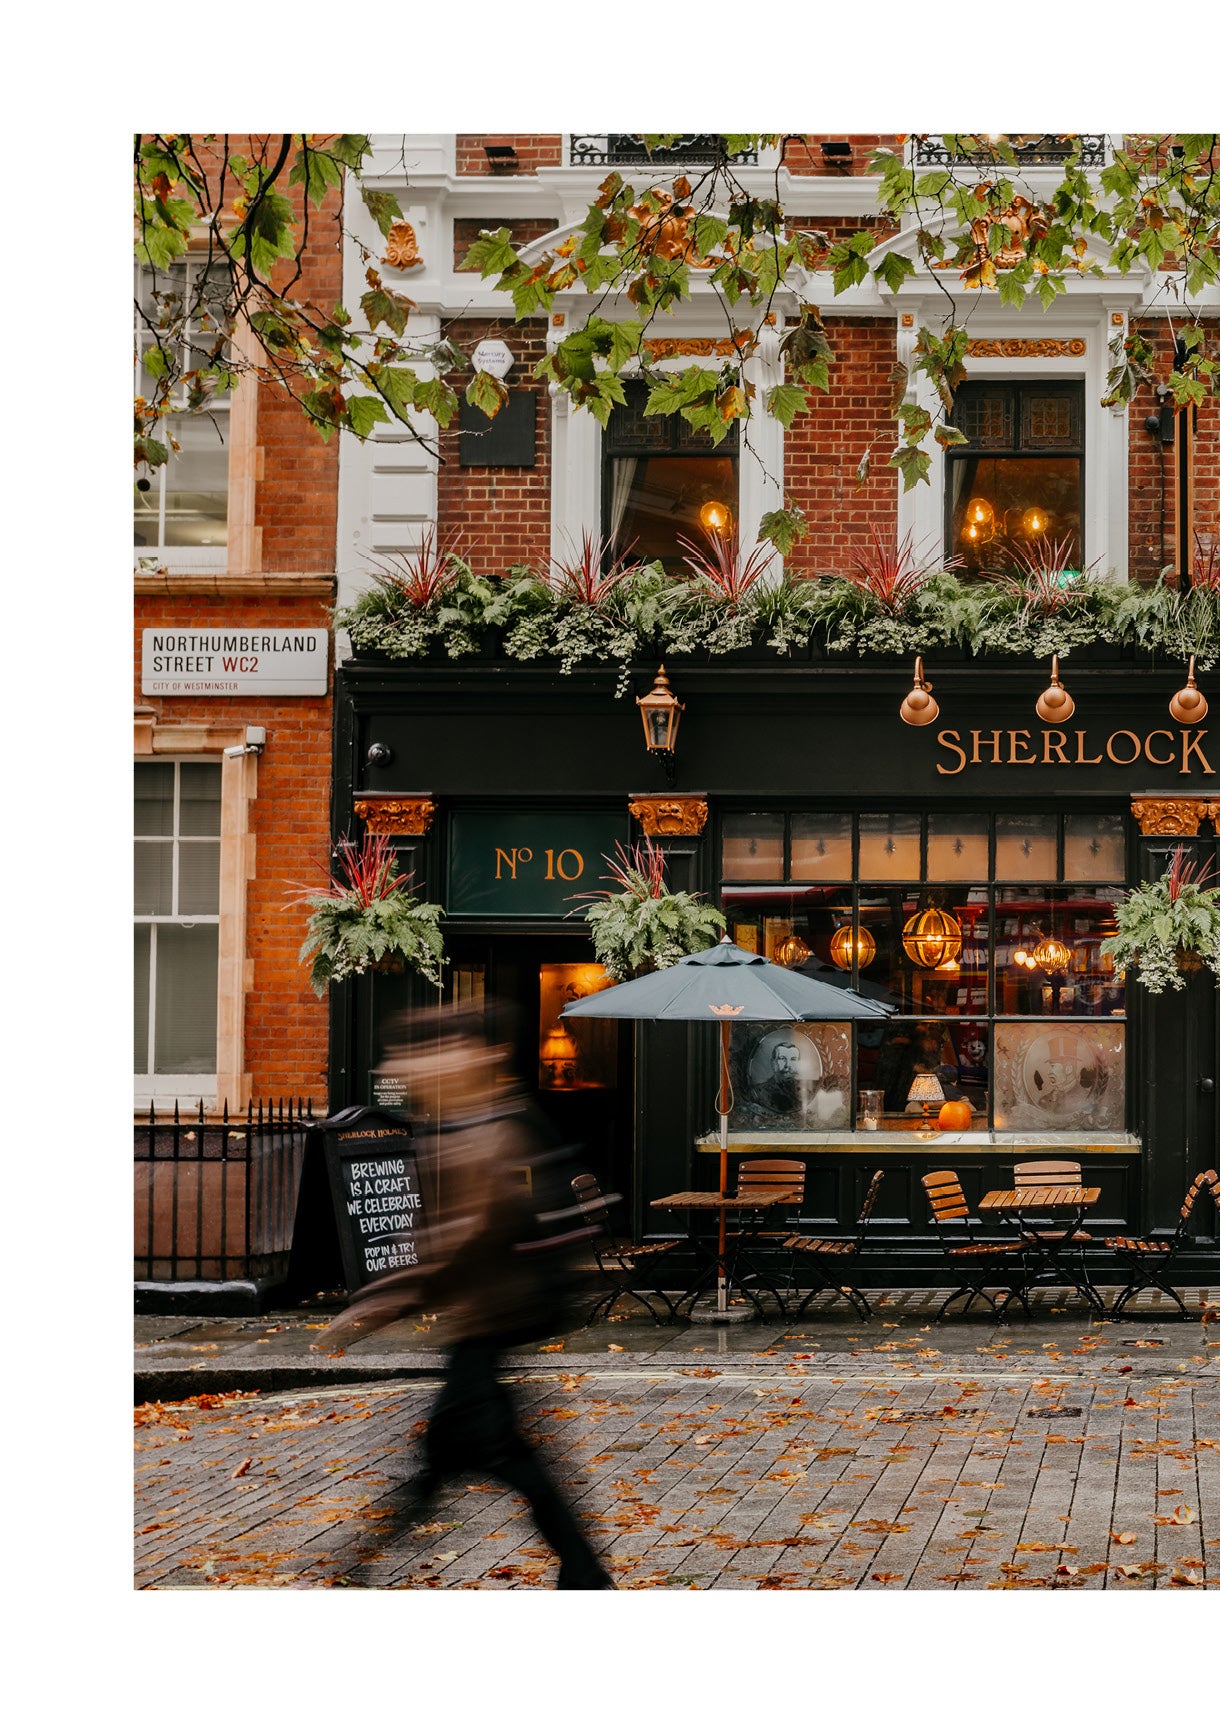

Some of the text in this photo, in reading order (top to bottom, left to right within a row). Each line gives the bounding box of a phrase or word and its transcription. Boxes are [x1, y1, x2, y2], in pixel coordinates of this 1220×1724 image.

[153, 635, 317, 652] NORTHUMBERLAND
[153, 656, 259, 673] STREET WC2
[152, 682, 239, 691] CITY OF WESTMINSTER
[935, 729, 1217, 775] SHERLOCK
[544, 848, 585, 881] 10
[377, 1127, 408, 1138] HOLMES
[350, 1158, 405, 1181] BREWING
[350, 1176, 411, 1197] IS A CRAFT
[346, 1193, 422, 1216] WE CELEBRATE
[359, 1212, 413, 1234] EVERYDAY
[364, 1241, 415, 1259] POP IN & TRY
[366, 1252, 419, 1272] OUR BEERS
